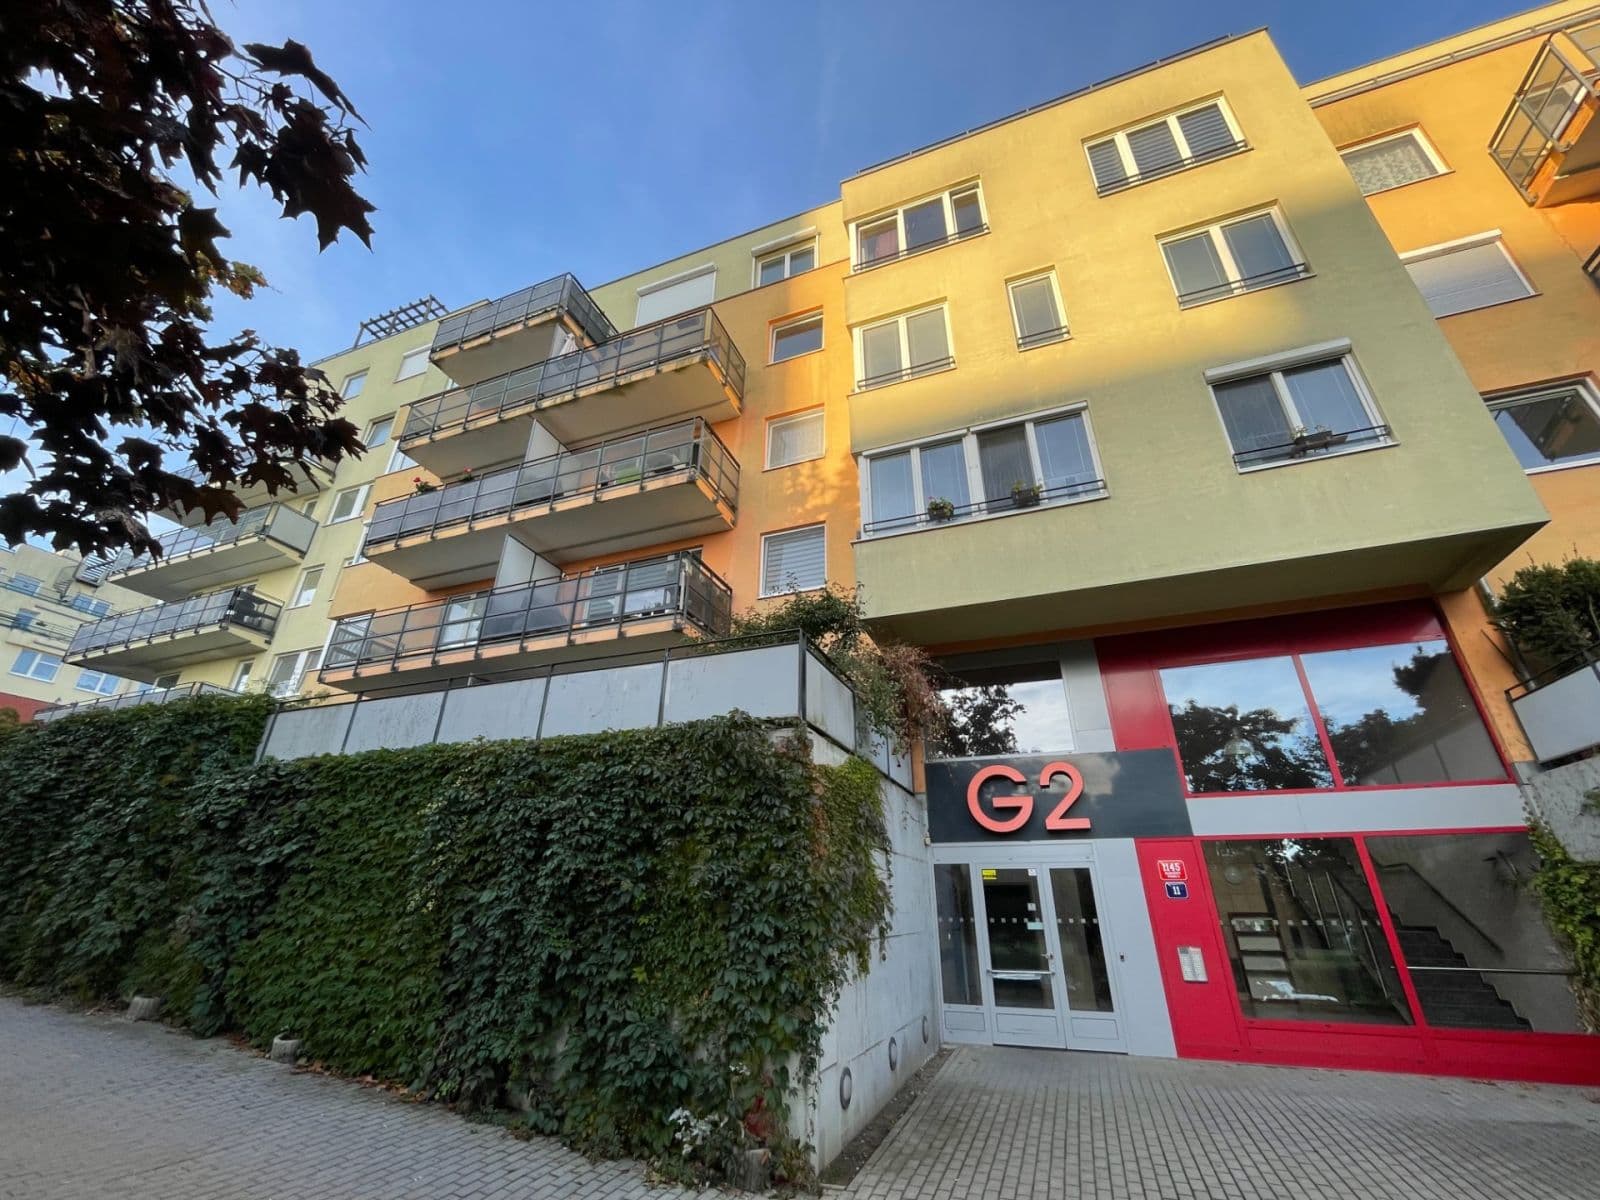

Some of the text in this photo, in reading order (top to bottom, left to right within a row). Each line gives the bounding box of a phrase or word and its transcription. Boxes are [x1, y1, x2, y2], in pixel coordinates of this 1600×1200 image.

[967, 761, 1091, 833] G2
[1162, 862, 1181, 872] 1145
[1172, 885, 1181, 896] 11
